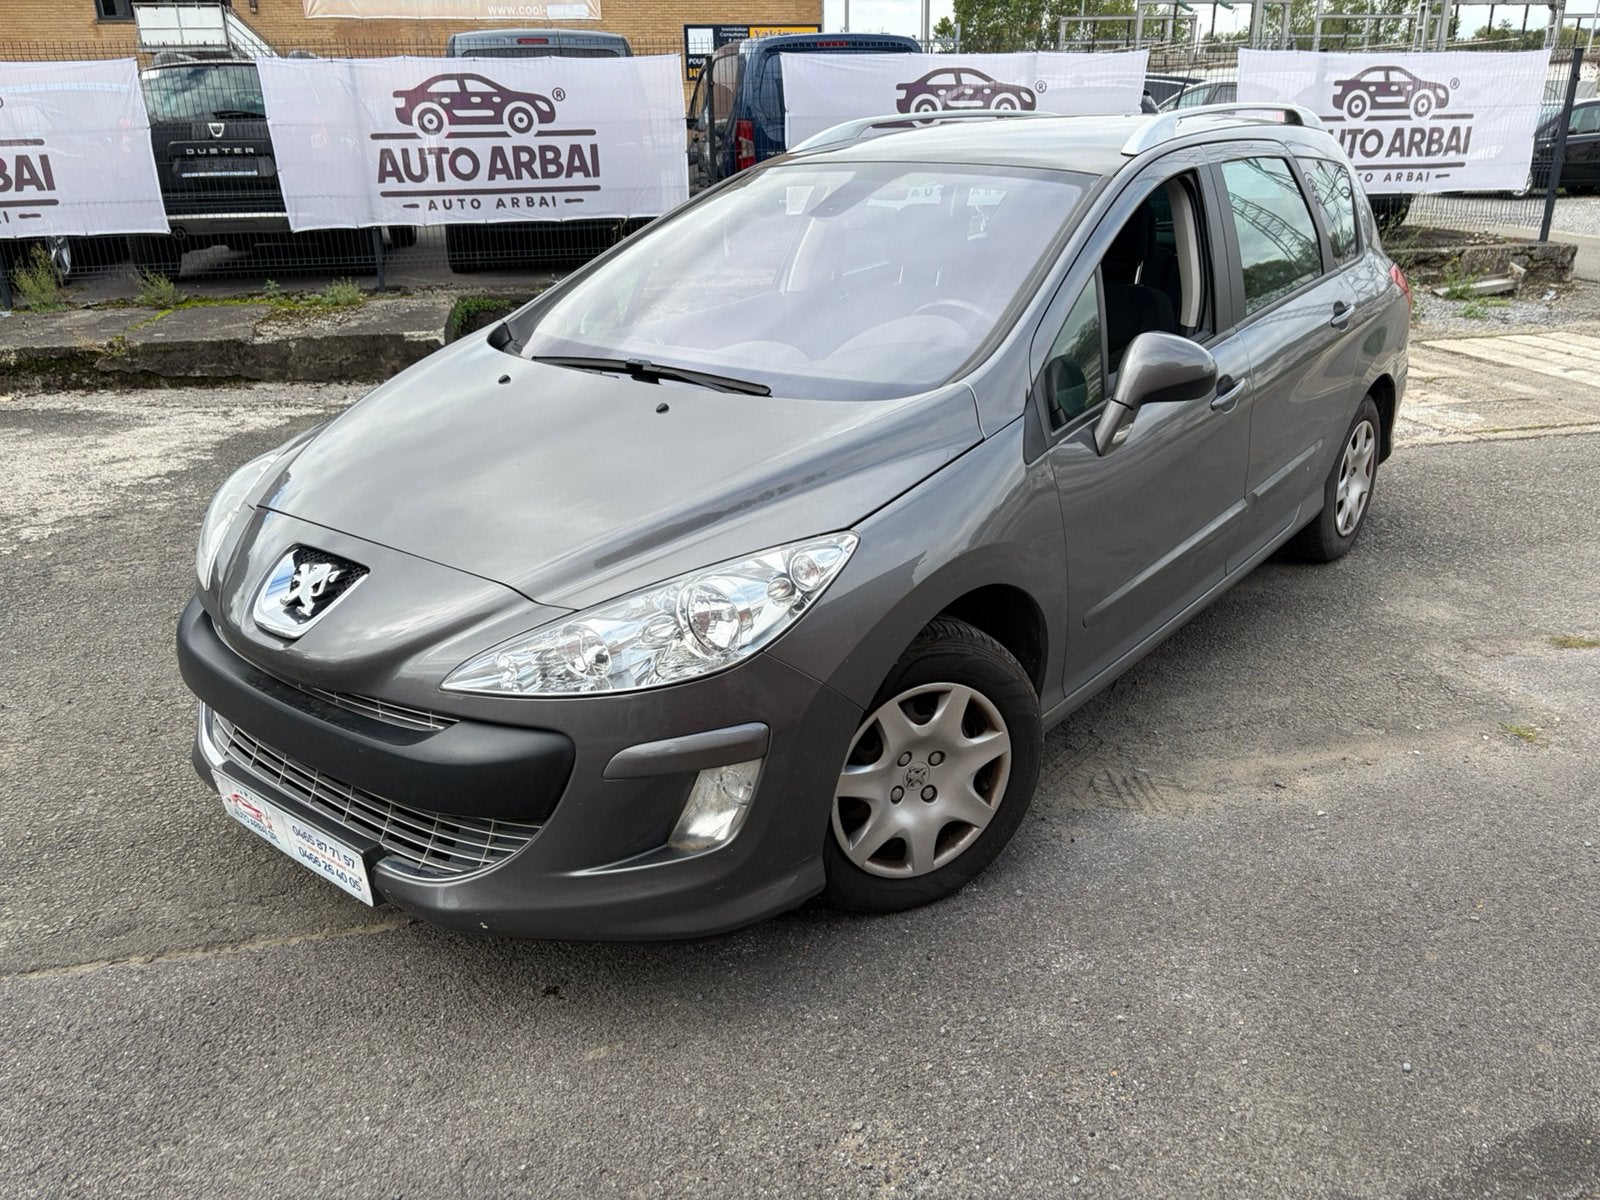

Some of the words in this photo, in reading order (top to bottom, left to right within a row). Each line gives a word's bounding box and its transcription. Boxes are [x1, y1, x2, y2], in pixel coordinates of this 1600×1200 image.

[487, 4, 547, 16] www.cool-
[185, 147, 255, 156] DUSTER
[1385, 126, 1473, 159] ARBAI
[377, 147, 481, 184] AUTO
[487, 143, 601, 181] ARBAI
[1383, 170, 1431, 184] ARBAI
[428, 198, 482, 212] AUTO
[495, 195, 558, 211] ARBAI
[292, 825, 315, 846] 0465
[316, 838, 328, 853] 87
[329, 846, 341, 862] 71
[343, 854, 355, 869] 57
[298, 846, 321, 868] 0466
[321, 860, 335, 876] 26
[335, 869, 348, 884] 40
[348, 876, 362, 892] 05
